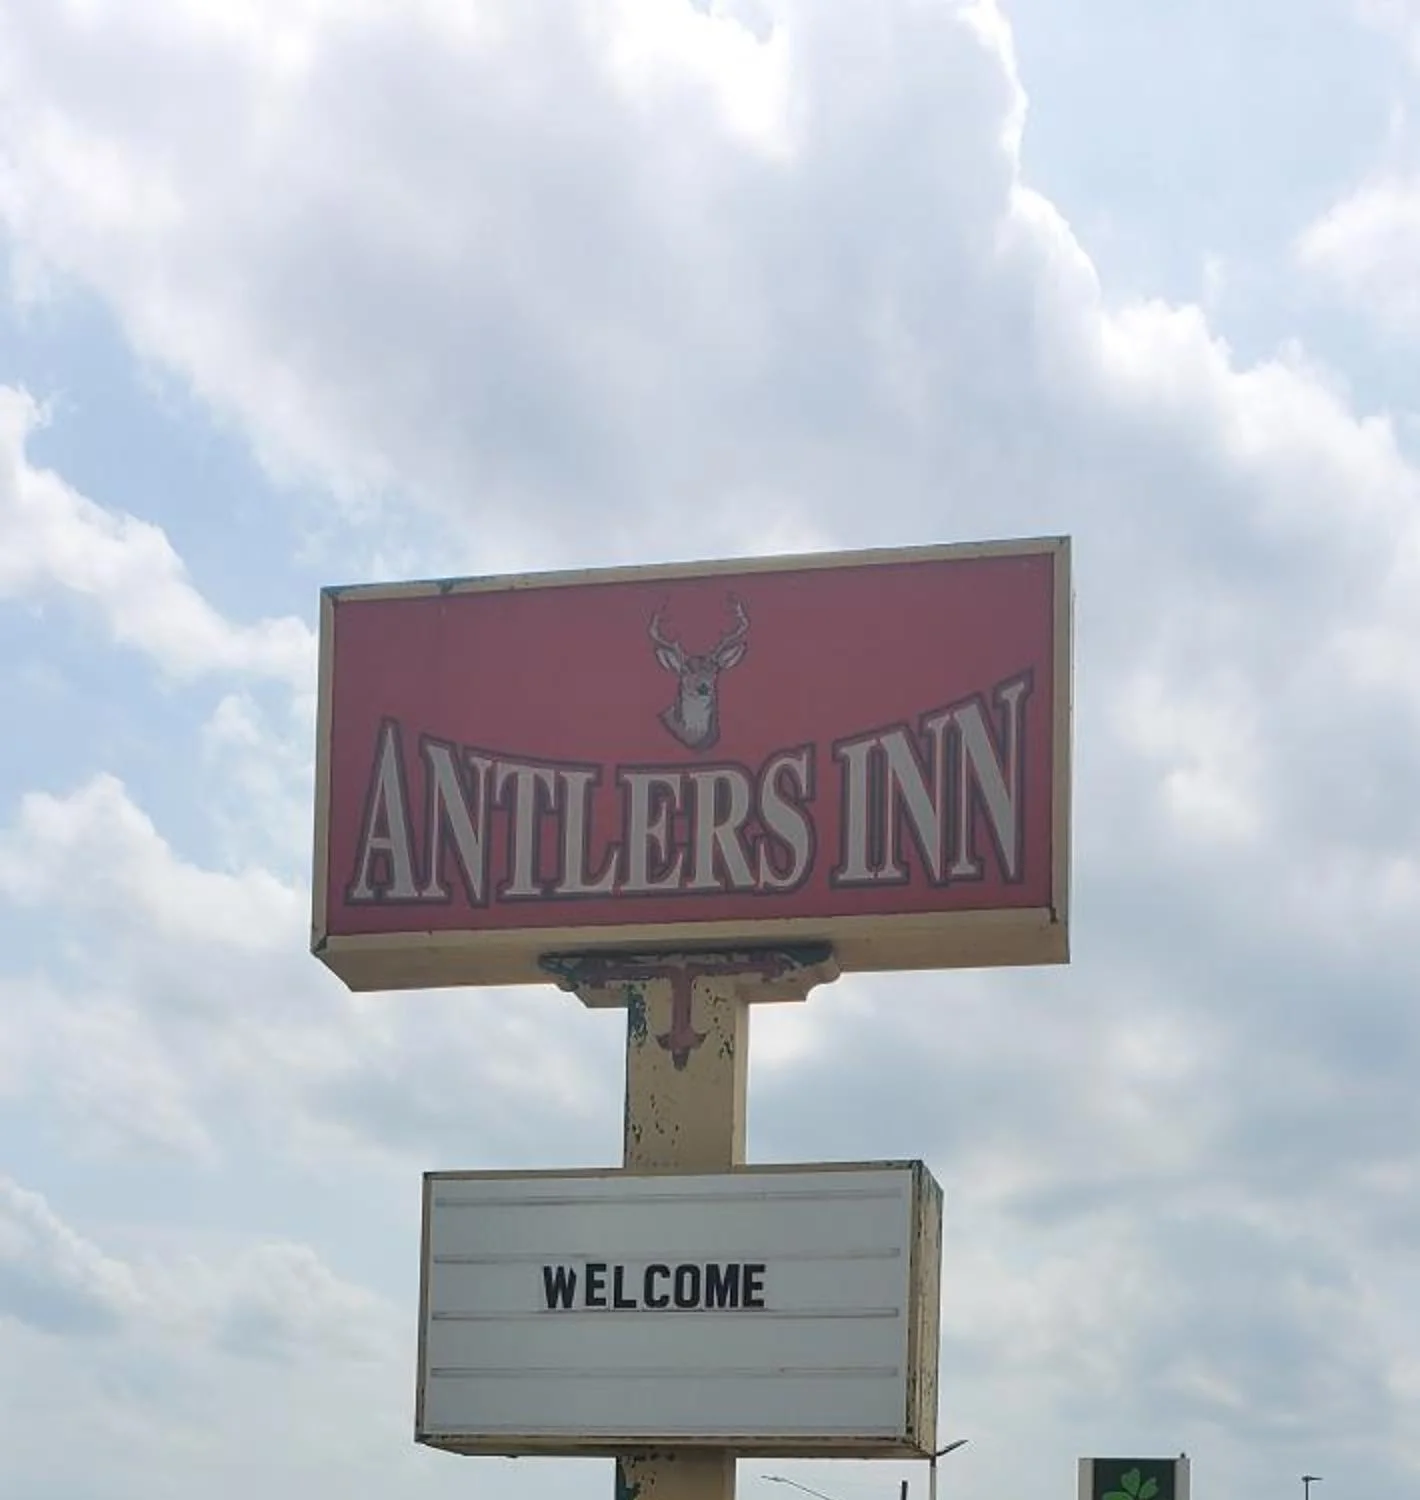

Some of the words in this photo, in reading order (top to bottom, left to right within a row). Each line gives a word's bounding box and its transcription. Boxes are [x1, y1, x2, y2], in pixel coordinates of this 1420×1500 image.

[348, 718, 816, 903] ANTLERS
[833, 677, 1028, 886] INN
[543, 1263, 766, 1309] WELCOME
